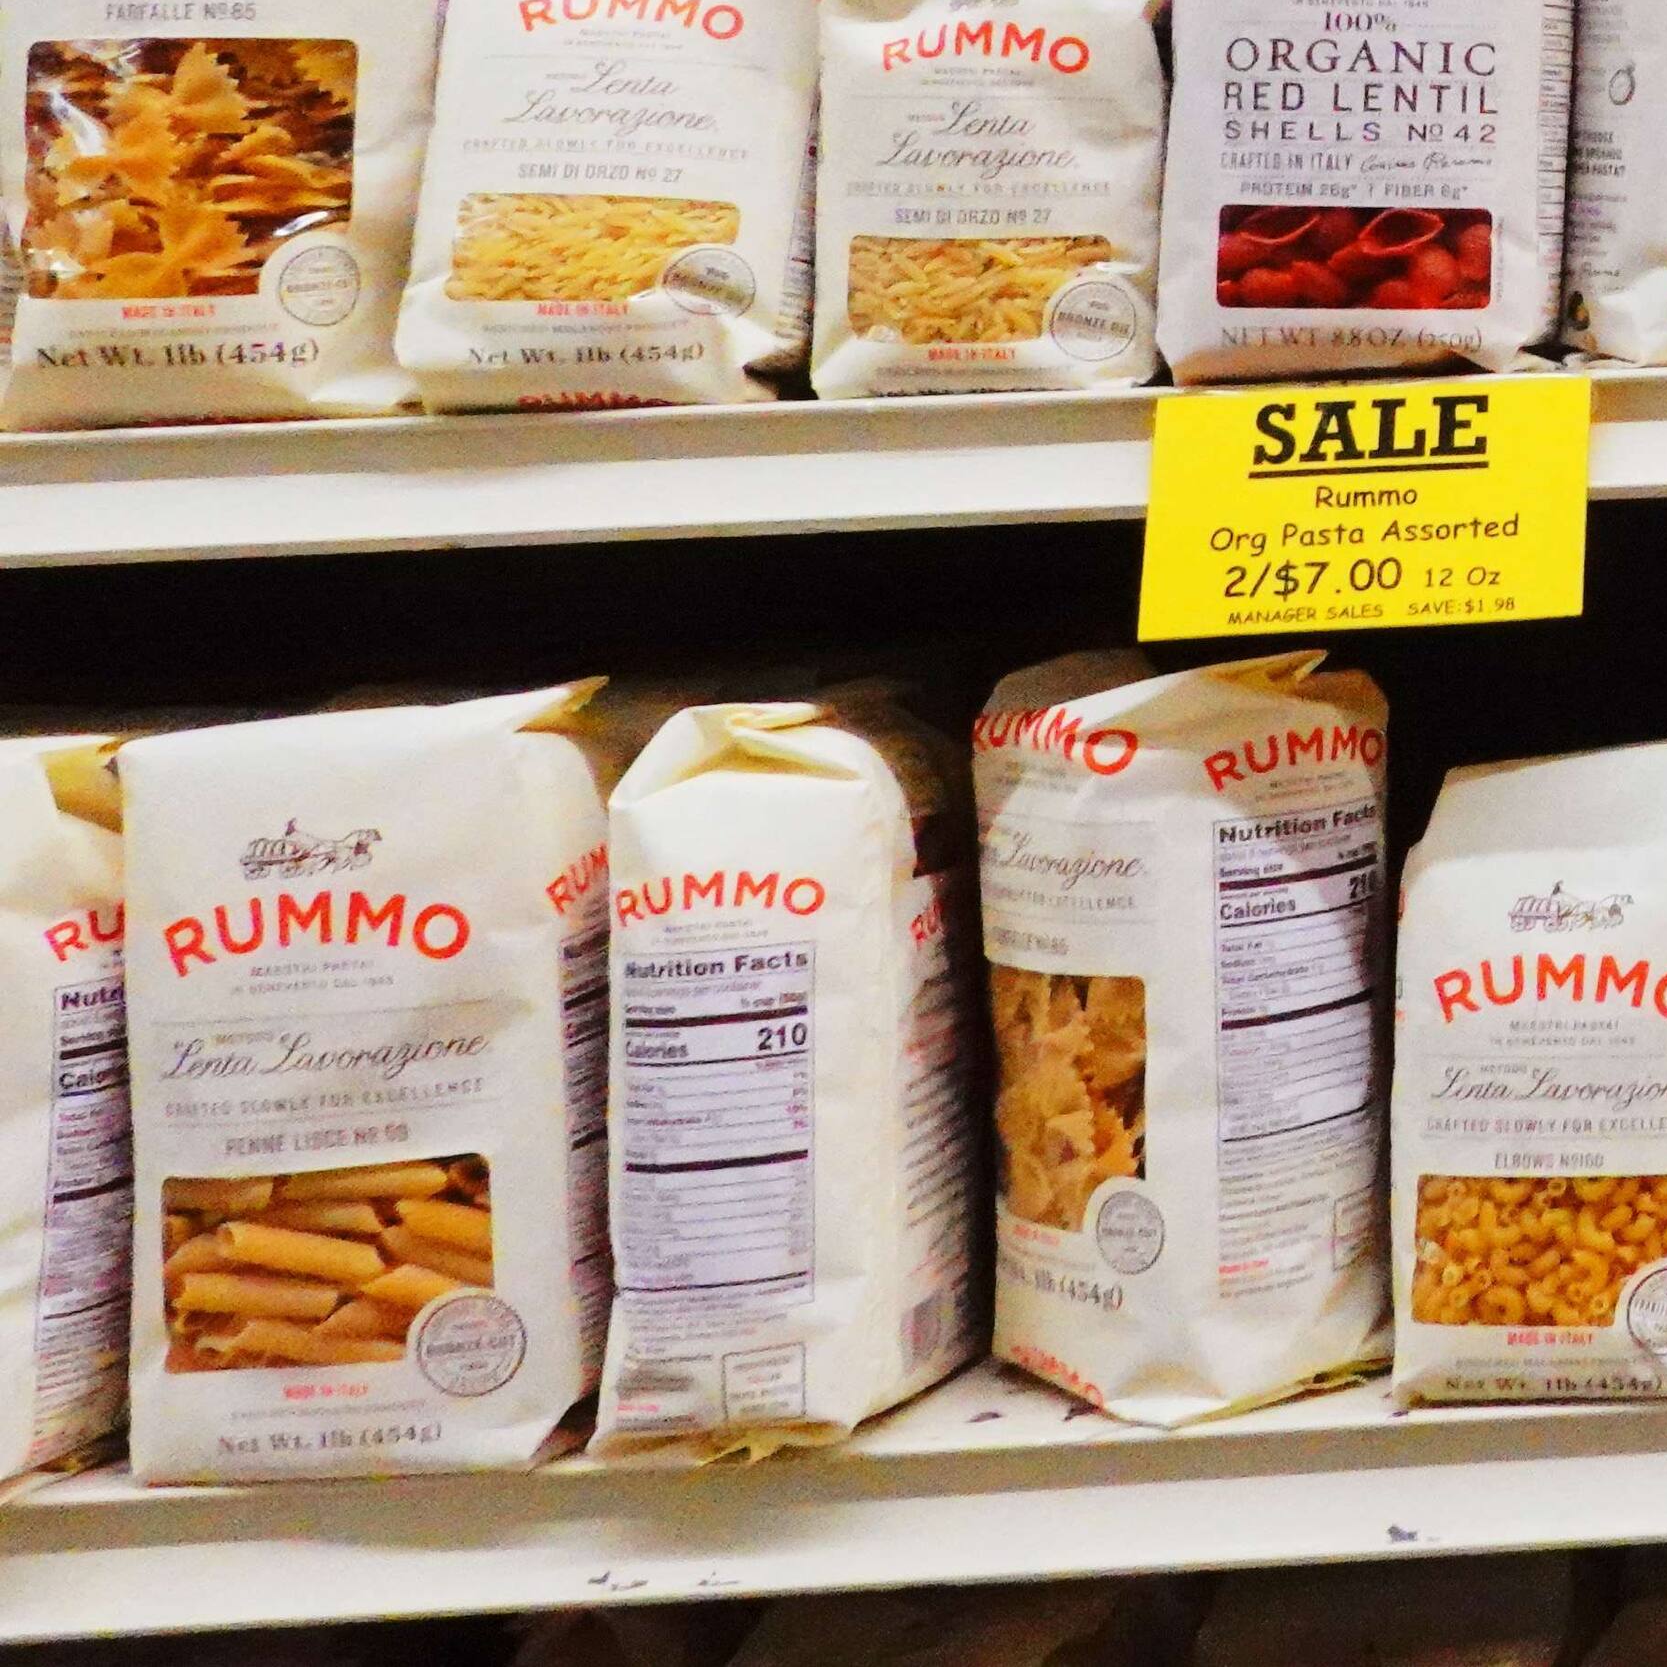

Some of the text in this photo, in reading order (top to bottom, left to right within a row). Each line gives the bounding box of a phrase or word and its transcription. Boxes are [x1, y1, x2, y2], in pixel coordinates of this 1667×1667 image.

[882, 18, 1091, 75] RUMMO
[1225, 38, 1497, 74] ORGANIC
[1223, 82, 1499, 116] RED LENTIL
[1224, 120, 1382, 142] SHELLS
[1252, 394, 1489, 465] SALE
[1315, 484, 1417, 509] Rummo
[1210, 514, 1519, 556] Org Pasta Assorted
[1424, 568, 1453, 588] 12
[1466, 566, 1501, 587] Oz
[1227, 603, 1384, 625] MANAGER SALES
[1204, 725, 1386, 793] RUMMO
[616, 868, 827, 928] RUMMO
[1220, 895, 1297, 923] Calories
[163, 889, 471, 979] RUMMO
[623, 950, 810, 981] Nutrition Facts
[756, 1021, 809, 1052] 210
